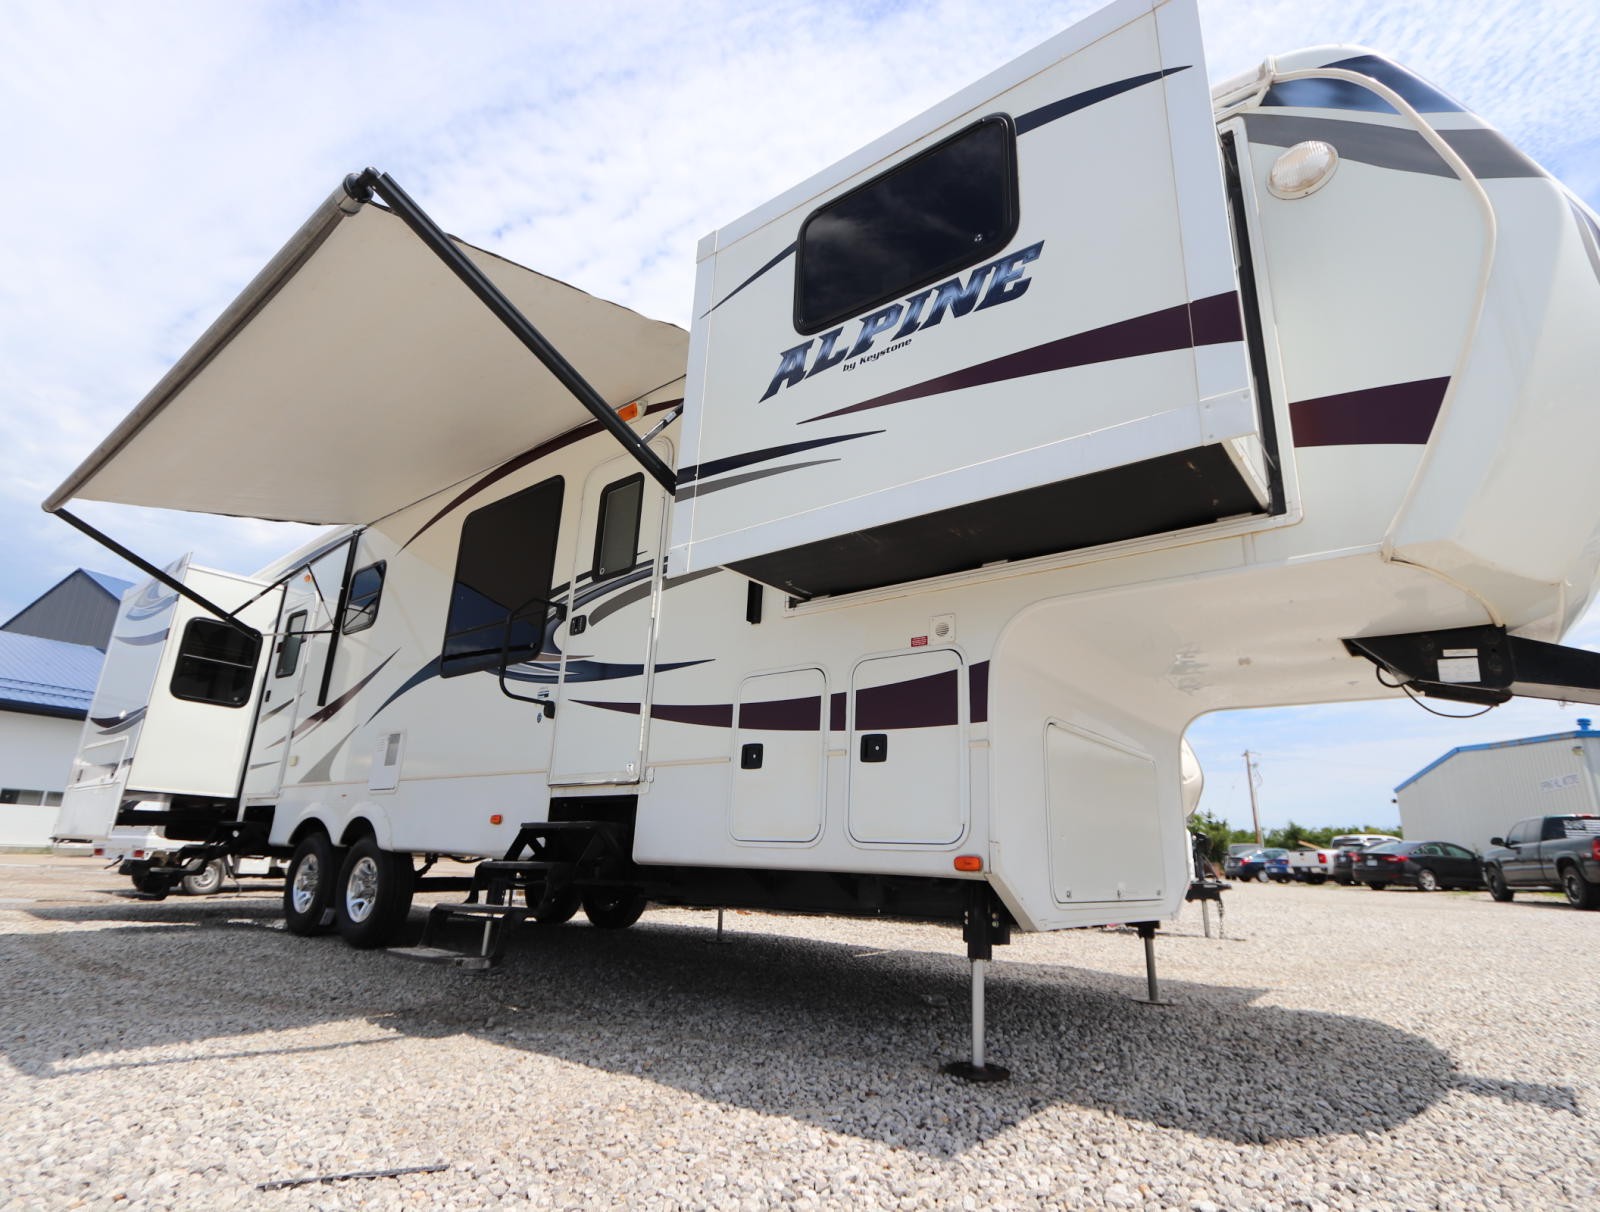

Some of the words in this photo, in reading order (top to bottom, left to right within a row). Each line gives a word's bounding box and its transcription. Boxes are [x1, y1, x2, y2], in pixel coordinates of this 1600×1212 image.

[758, 240, 1045, 404] ALPINE
[843, 362, 856, 372] by
[860, 338, 912, 365] Keystone
